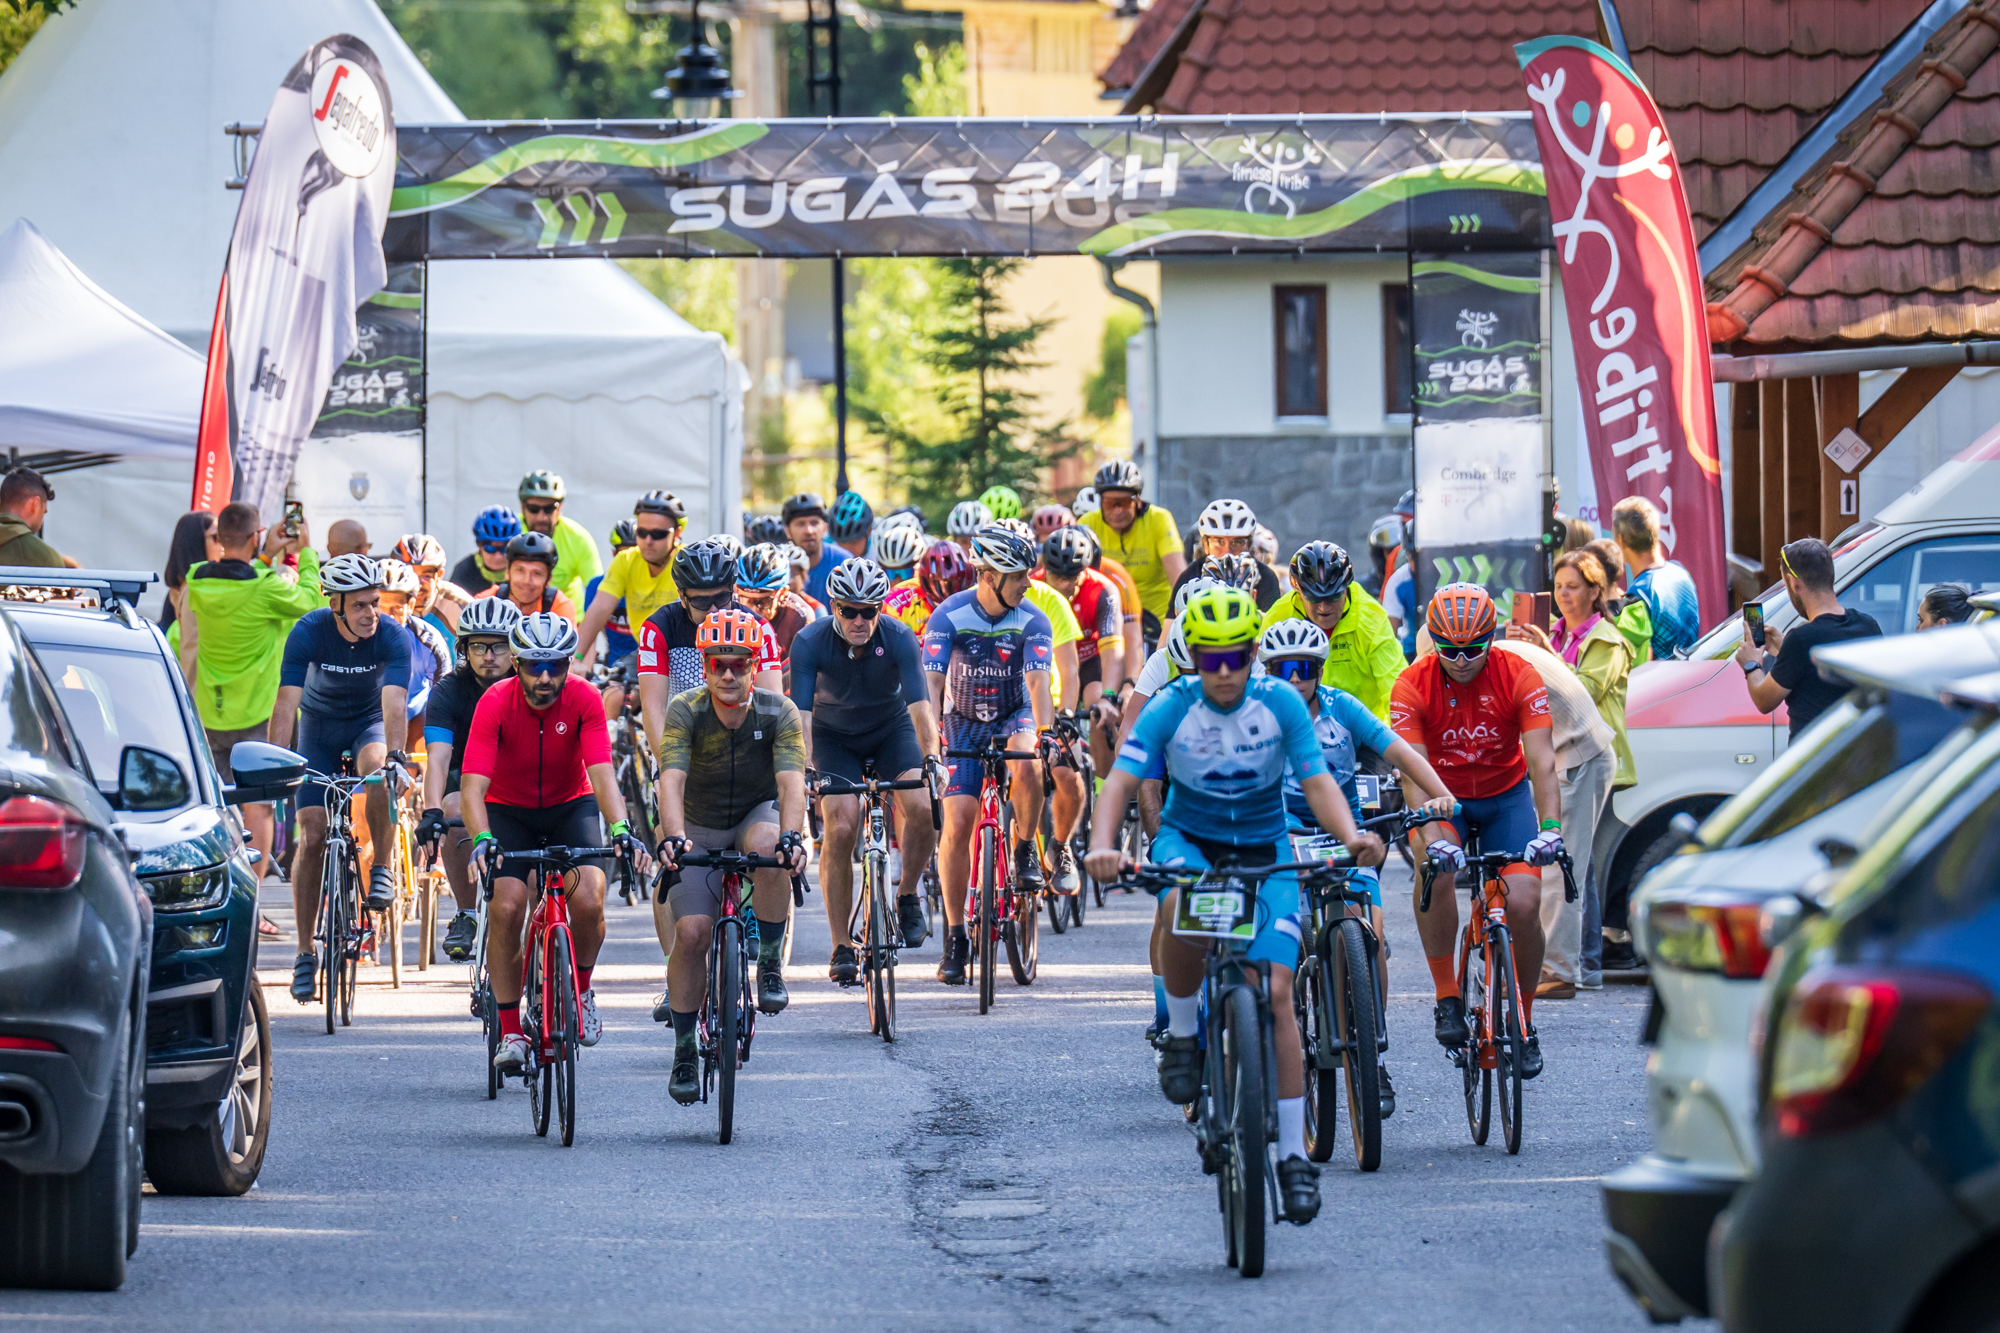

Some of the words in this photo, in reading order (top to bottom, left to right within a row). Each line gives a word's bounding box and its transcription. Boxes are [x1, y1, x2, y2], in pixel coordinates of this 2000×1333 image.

[1232, 161, 1272, 183] fitness
[1280, 172, 1311, 191] tribe
[667, 160, 982, 234] SUGÁS
[1002, 151, 1180, 210] 24H
[1428, 354, 1526, 380] SUGÁS
[328, 368, 404, 391] UGÁS
[1450, 373, 1506, 393] 24H
[328, 389, 385, 407] 24H
[1440, 466, 1517, 484] Combrdge
[1195, 896, 1239, 913] 29
